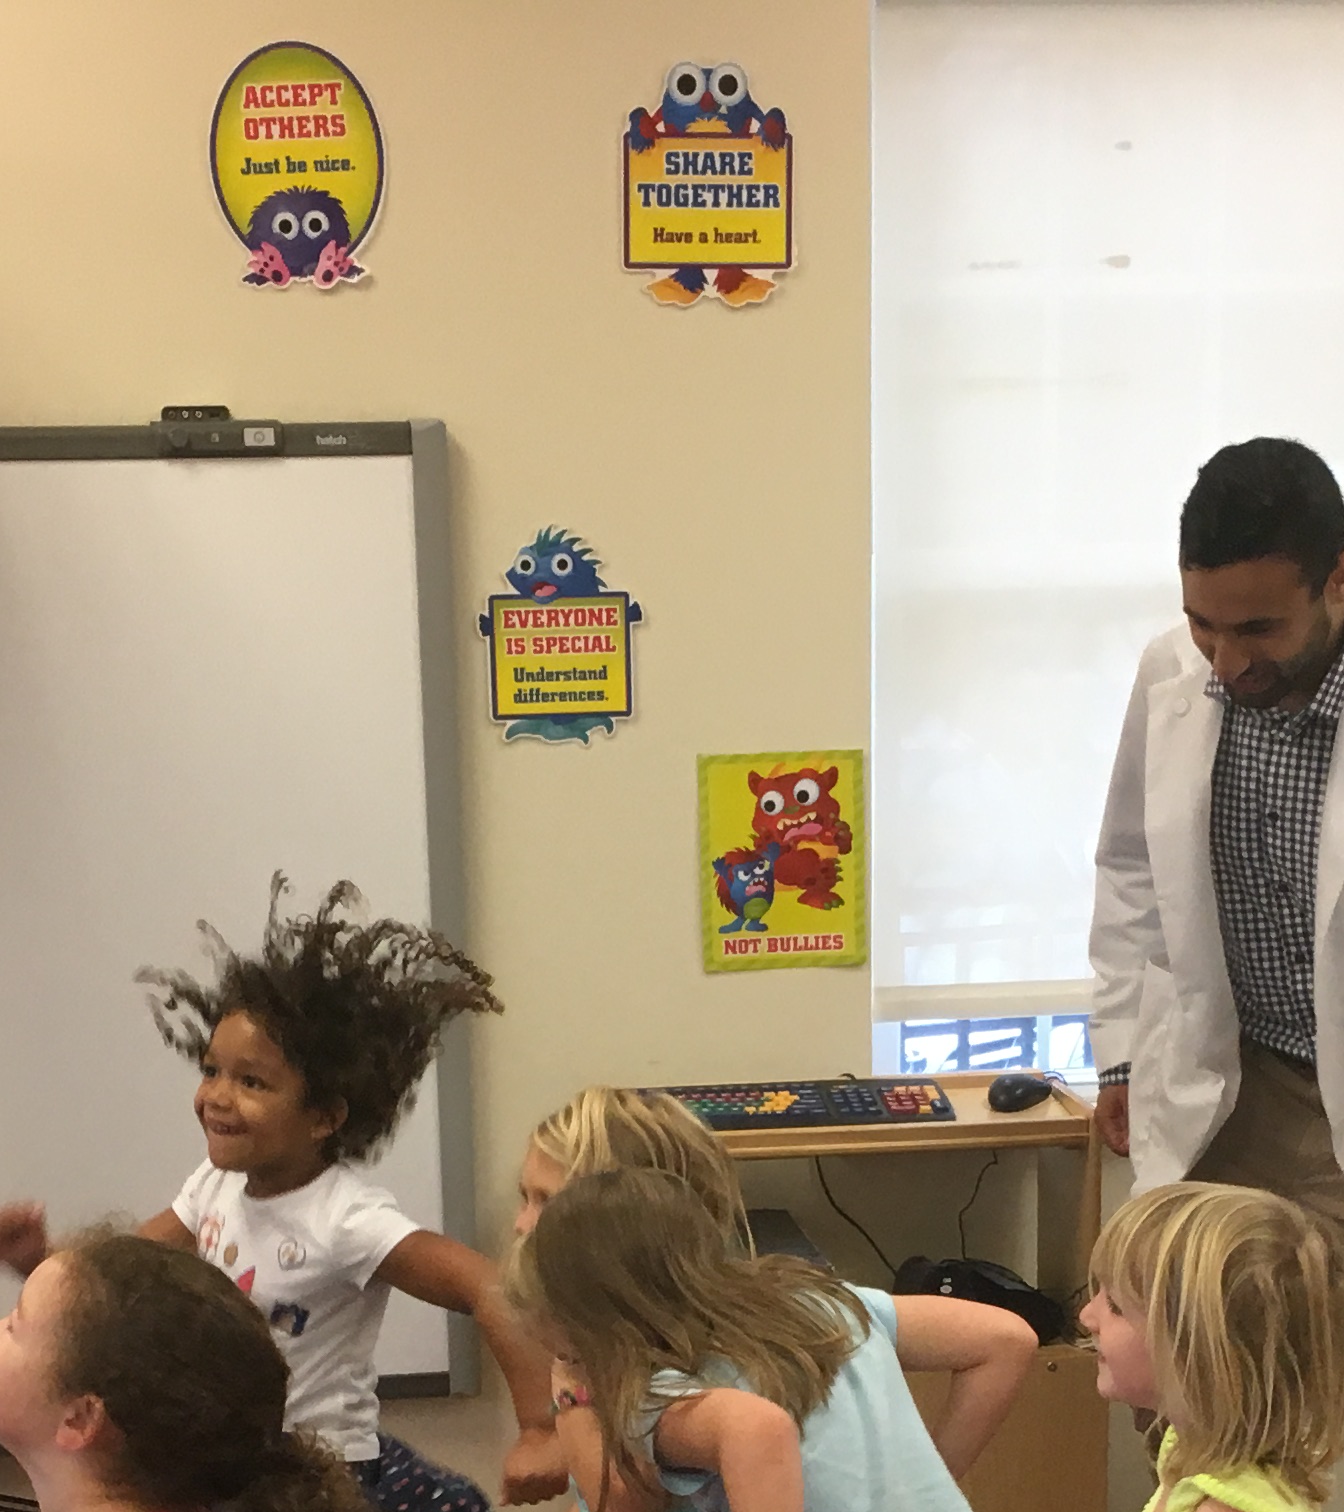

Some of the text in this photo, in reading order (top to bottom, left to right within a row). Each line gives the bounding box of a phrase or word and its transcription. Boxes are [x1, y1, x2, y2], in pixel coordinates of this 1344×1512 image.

[243, 82, 342, 109] ACCEPT
[243, 114, 346, 140] OTHERS
[240, 154, 356, 175] Just be nice.
[665, 151, 753, 176] SHARE
[637, 183, 780, 208] TOGETHER
[652, 227, 761, 244] Have a heart.
[503, 607, 618, 629] EVERYONE
[506, 635, 616, 655] IS SPECIAL
[513, 665, 608, 683] Understand
[513, 688, 609, 704] differences.
[724, 934, 844, 955] NOT BULLIES
